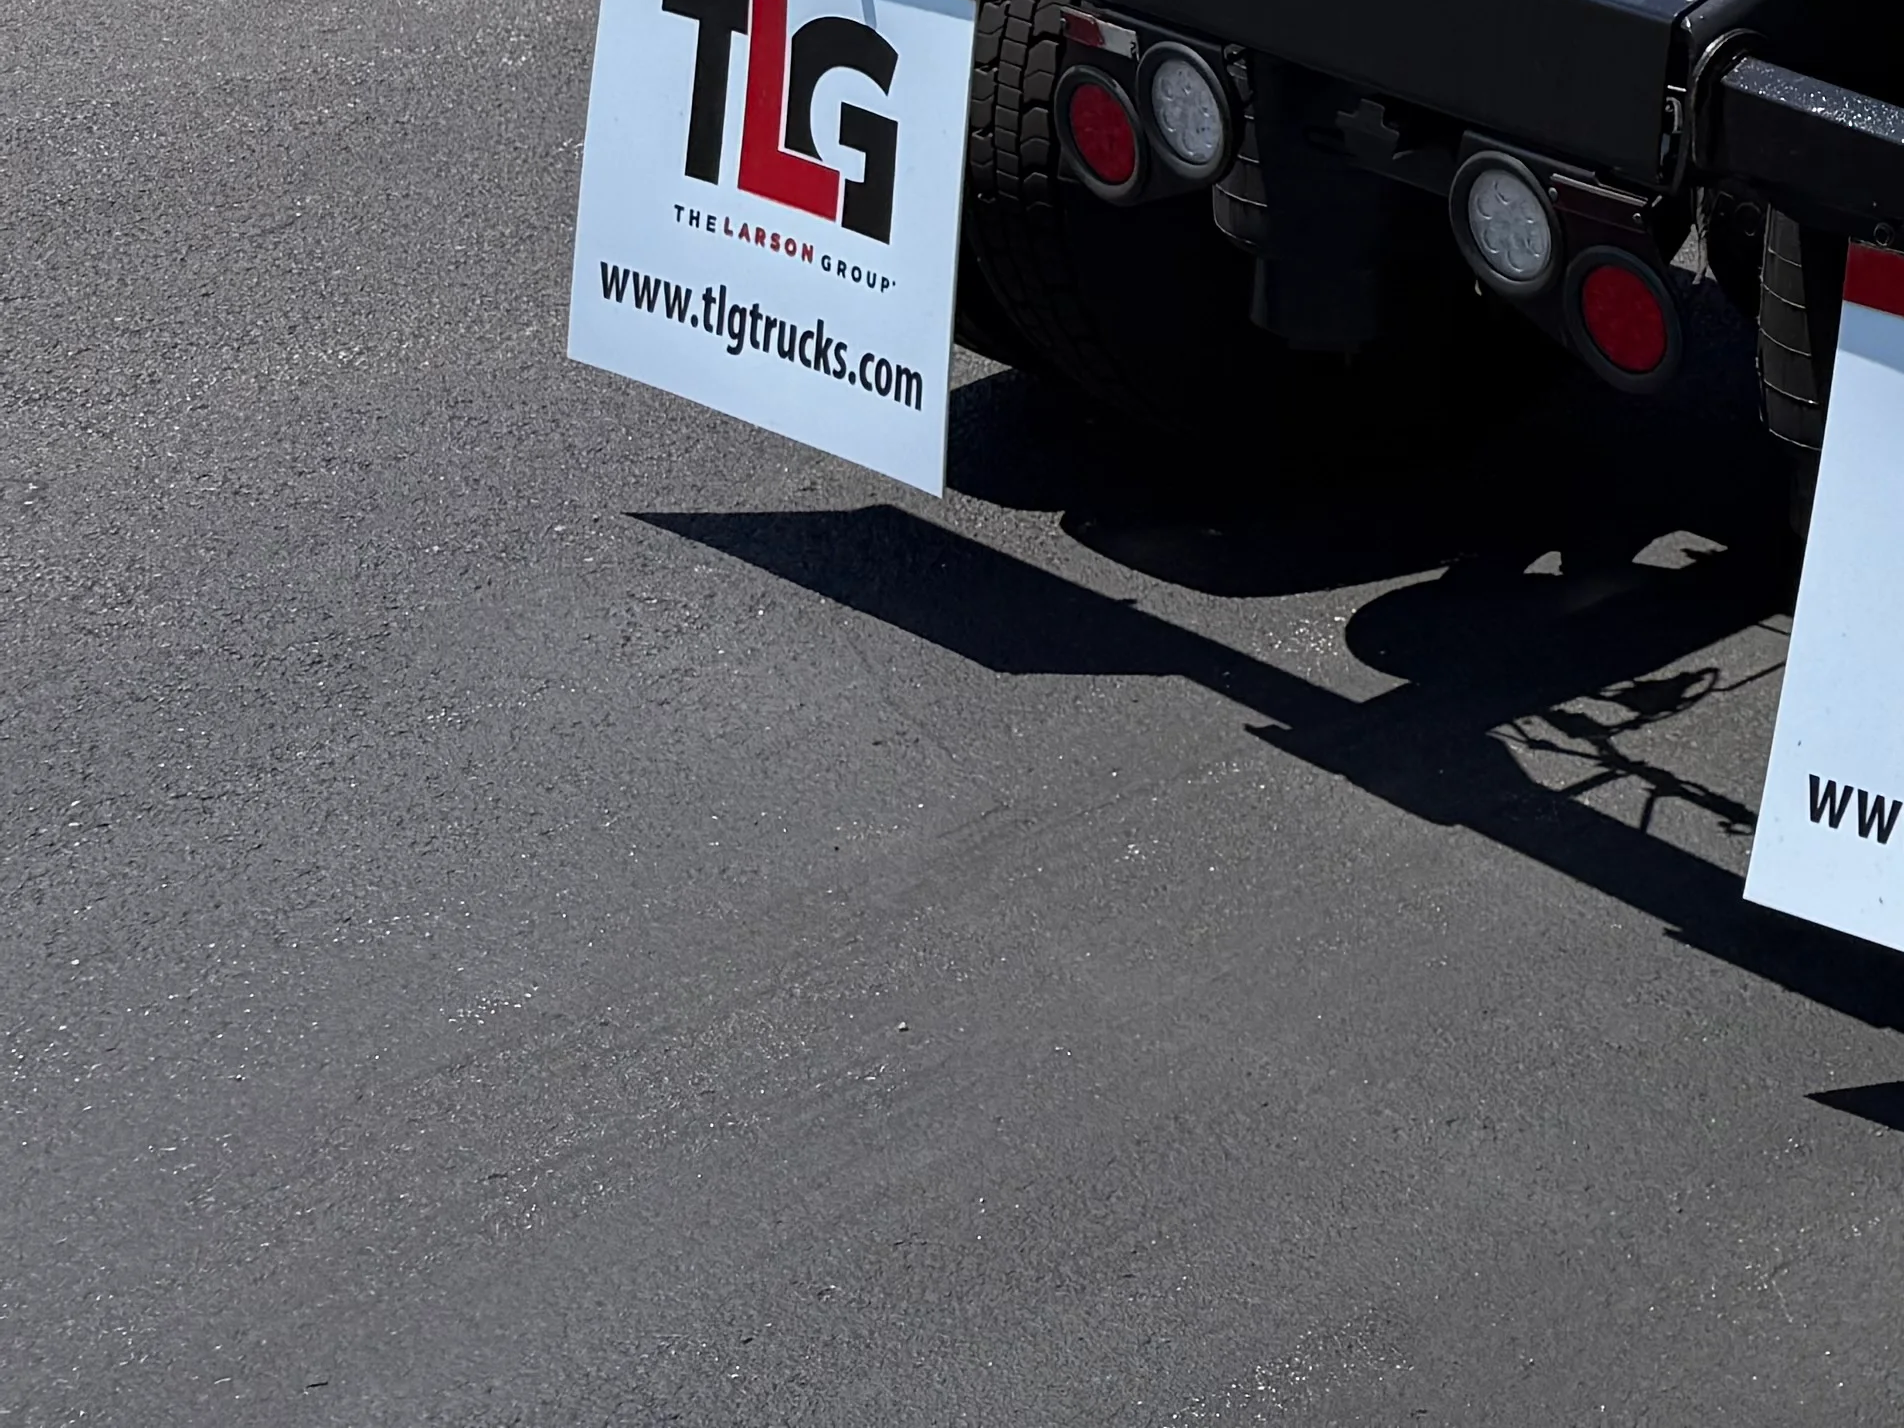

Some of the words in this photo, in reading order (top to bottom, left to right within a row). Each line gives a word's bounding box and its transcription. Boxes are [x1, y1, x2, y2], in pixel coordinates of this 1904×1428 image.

[673, 203, 718, 234] THE
[722, 216, 814, 265] LARSON
[820, 254, 891, 292] GROUP
[599, 260, 924, 411] www.tlgtrucks.com
